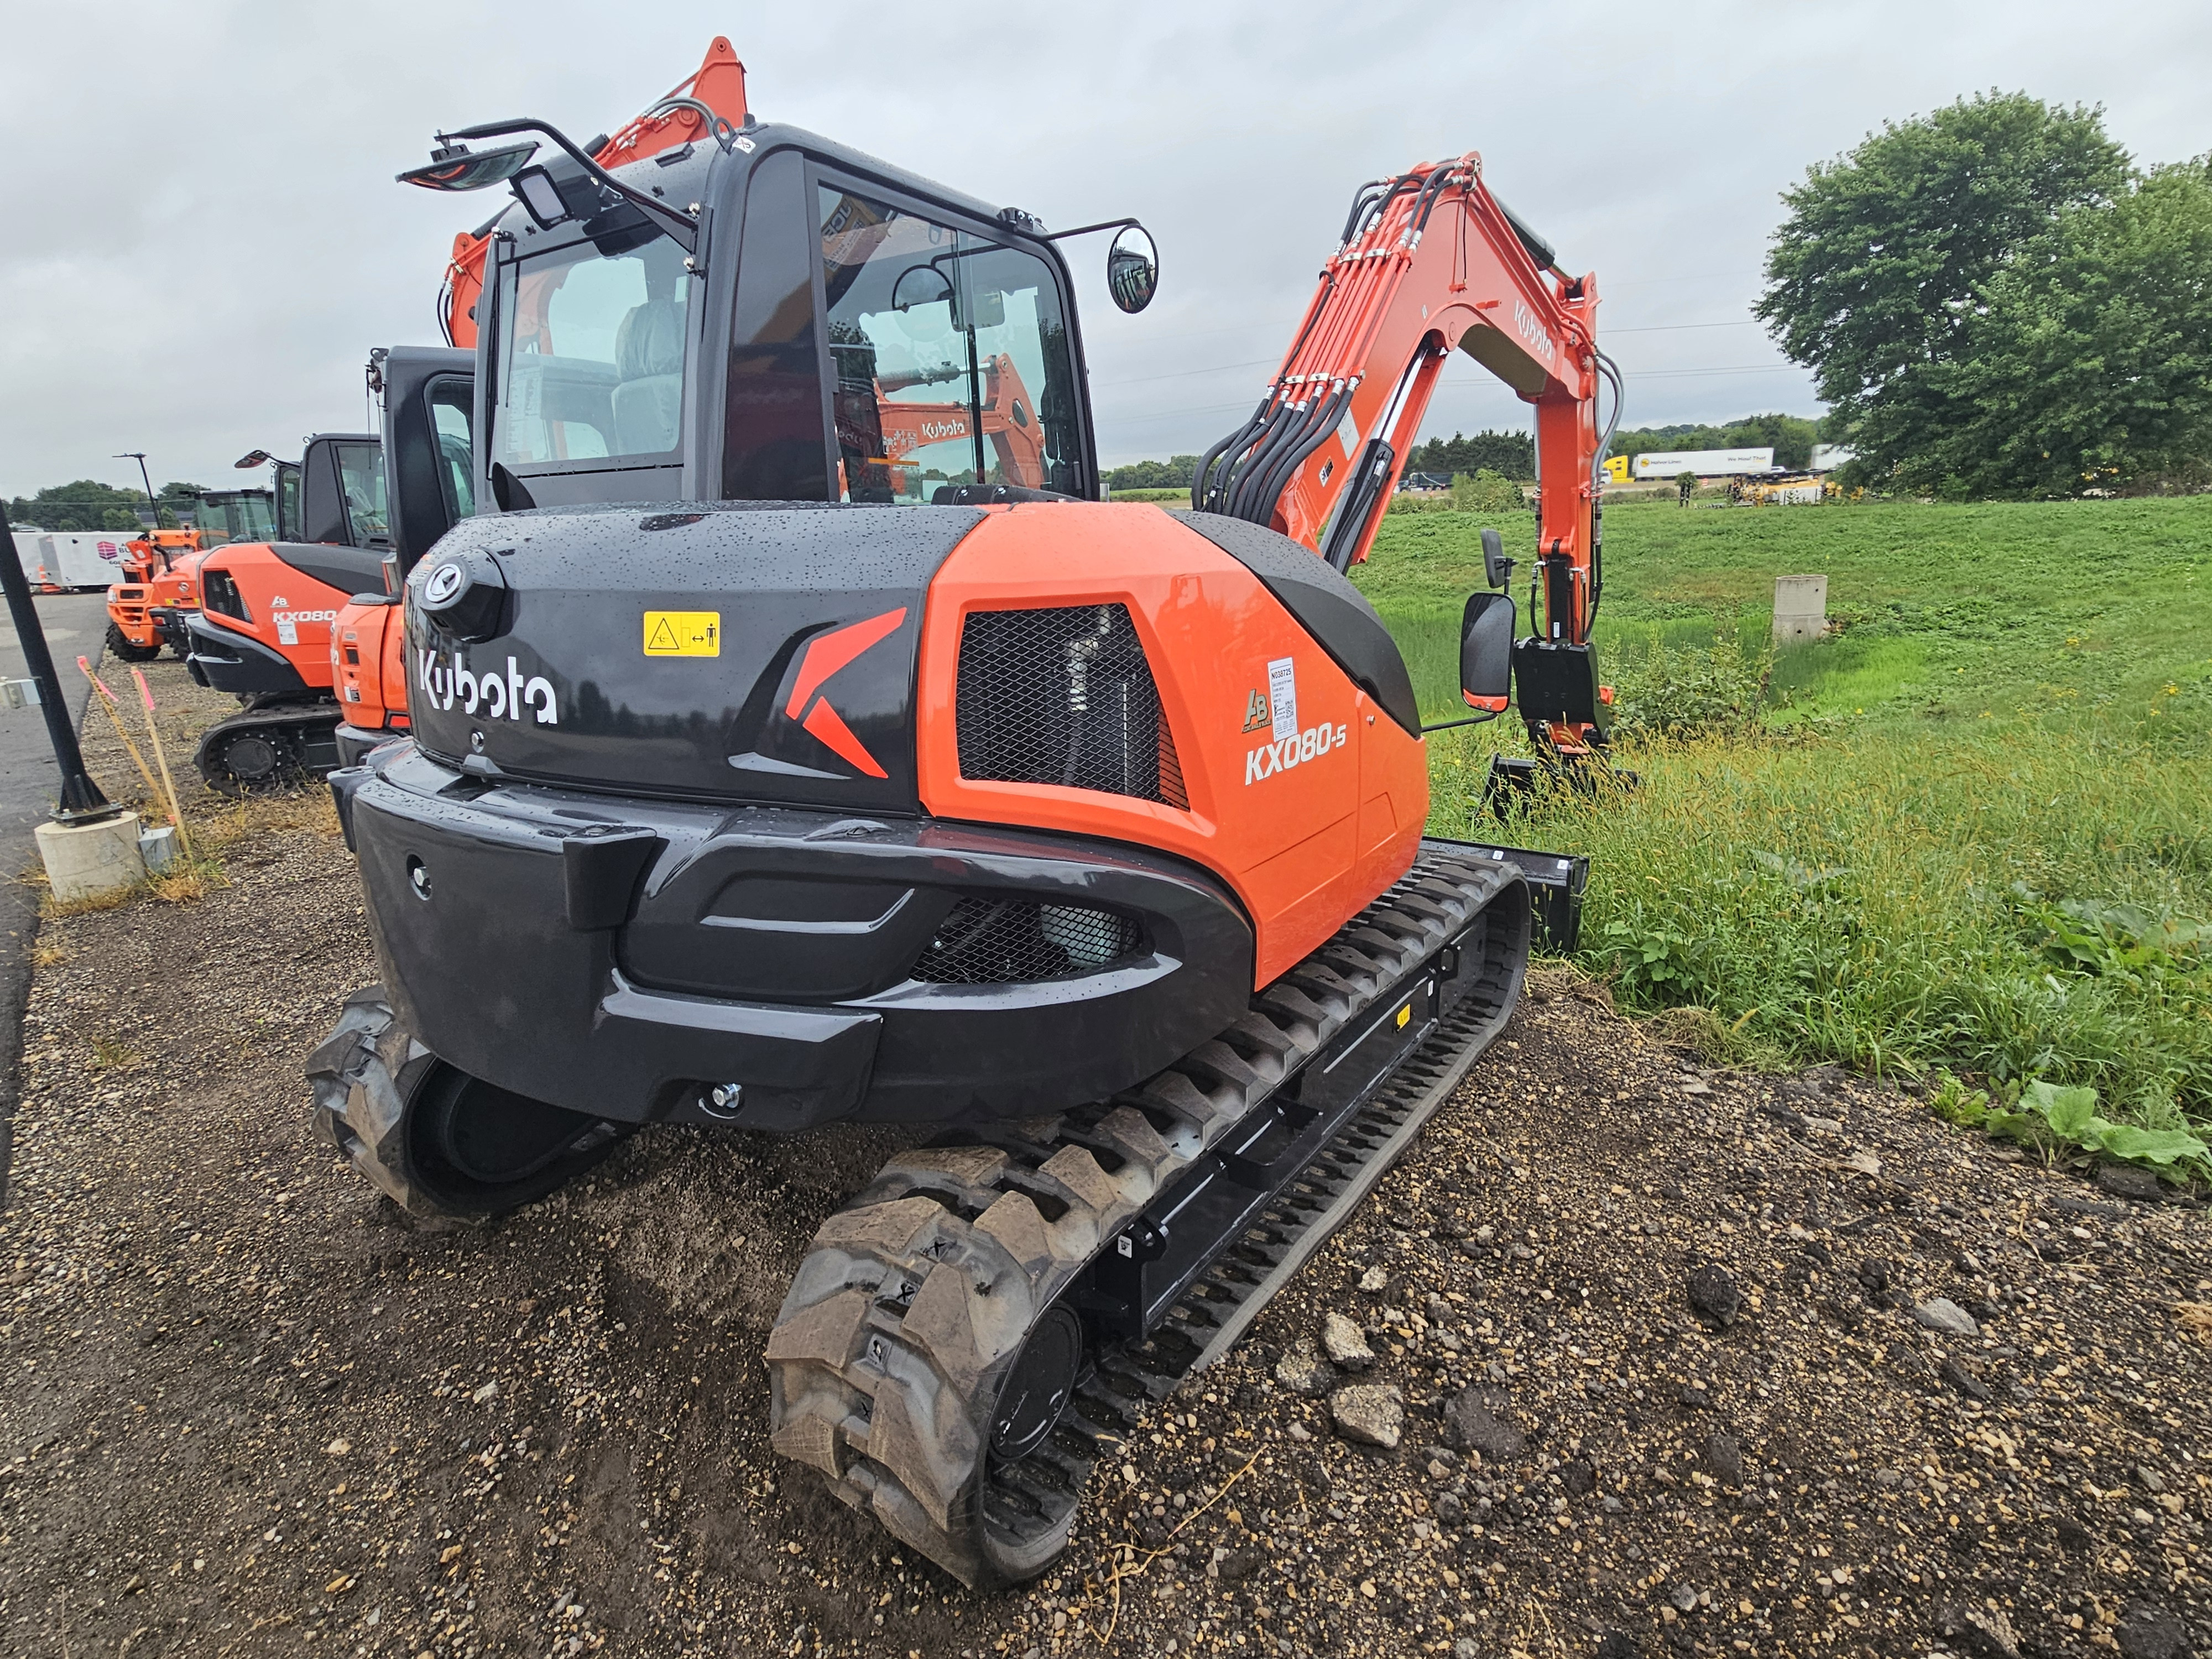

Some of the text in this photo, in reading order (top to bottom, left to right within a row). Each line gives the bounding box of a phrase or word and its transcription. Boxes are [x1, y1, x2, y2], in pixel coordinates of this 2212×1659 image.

[1515, 300, 1552, 361] Kubota
[922, 419, 965, 439] Kubota
[273, 610, 337, 623] KX080
[419, 649, 557, 724] Kubota
[1245, 722, 1347, 786] KX080-5
